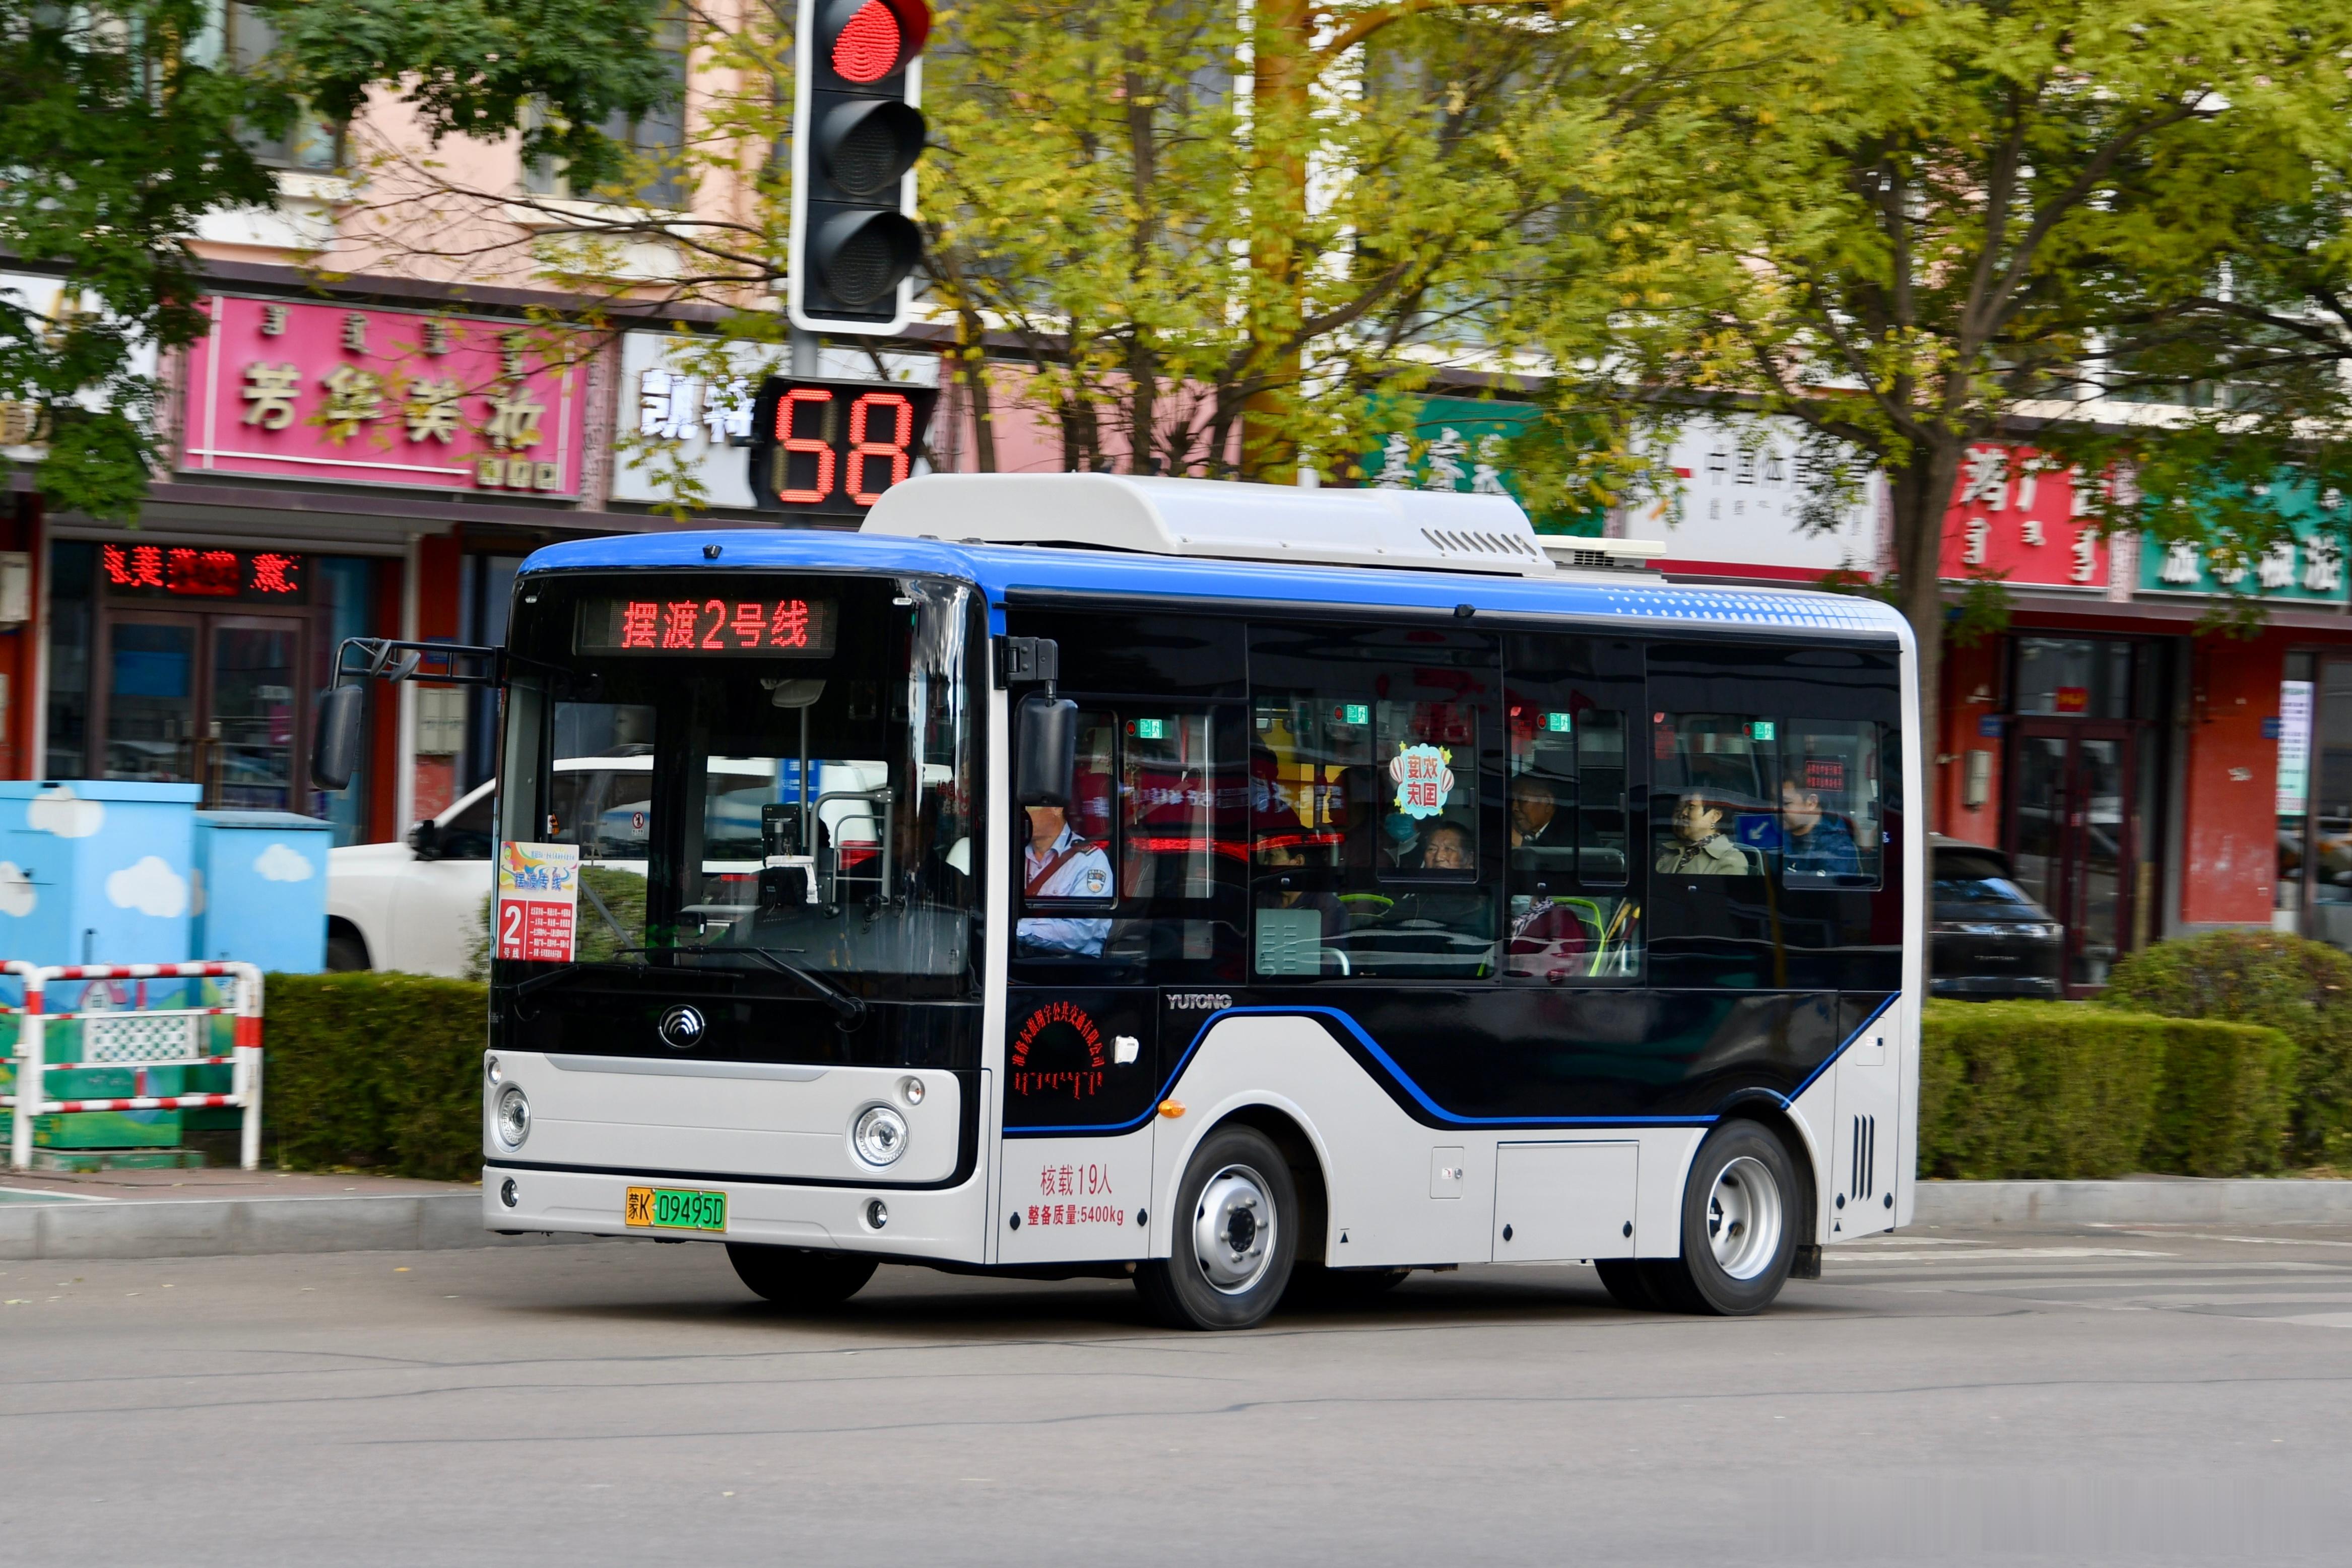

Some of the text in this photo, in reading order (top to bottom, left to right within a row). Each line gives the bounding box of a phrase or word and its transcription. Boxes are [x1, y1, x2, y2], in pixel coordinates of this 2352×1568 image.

[242, 361, 546, 449] 芳华美妆
[774, 388, 913, 504] 58
[621, 600, 808, 649] 摆渡2号线
[504, 905, 521, 944] 2
[504, 947, 519, 958] 号线
[1165, 994, 1232, 1009] YUTONG
[1040, 1164, 1112, 1196] 核载19人
[628, 1193, 723, 1225] 蒙K 09495D
[1028, 1205, 1124, 1226] 整备质量:5400kg
